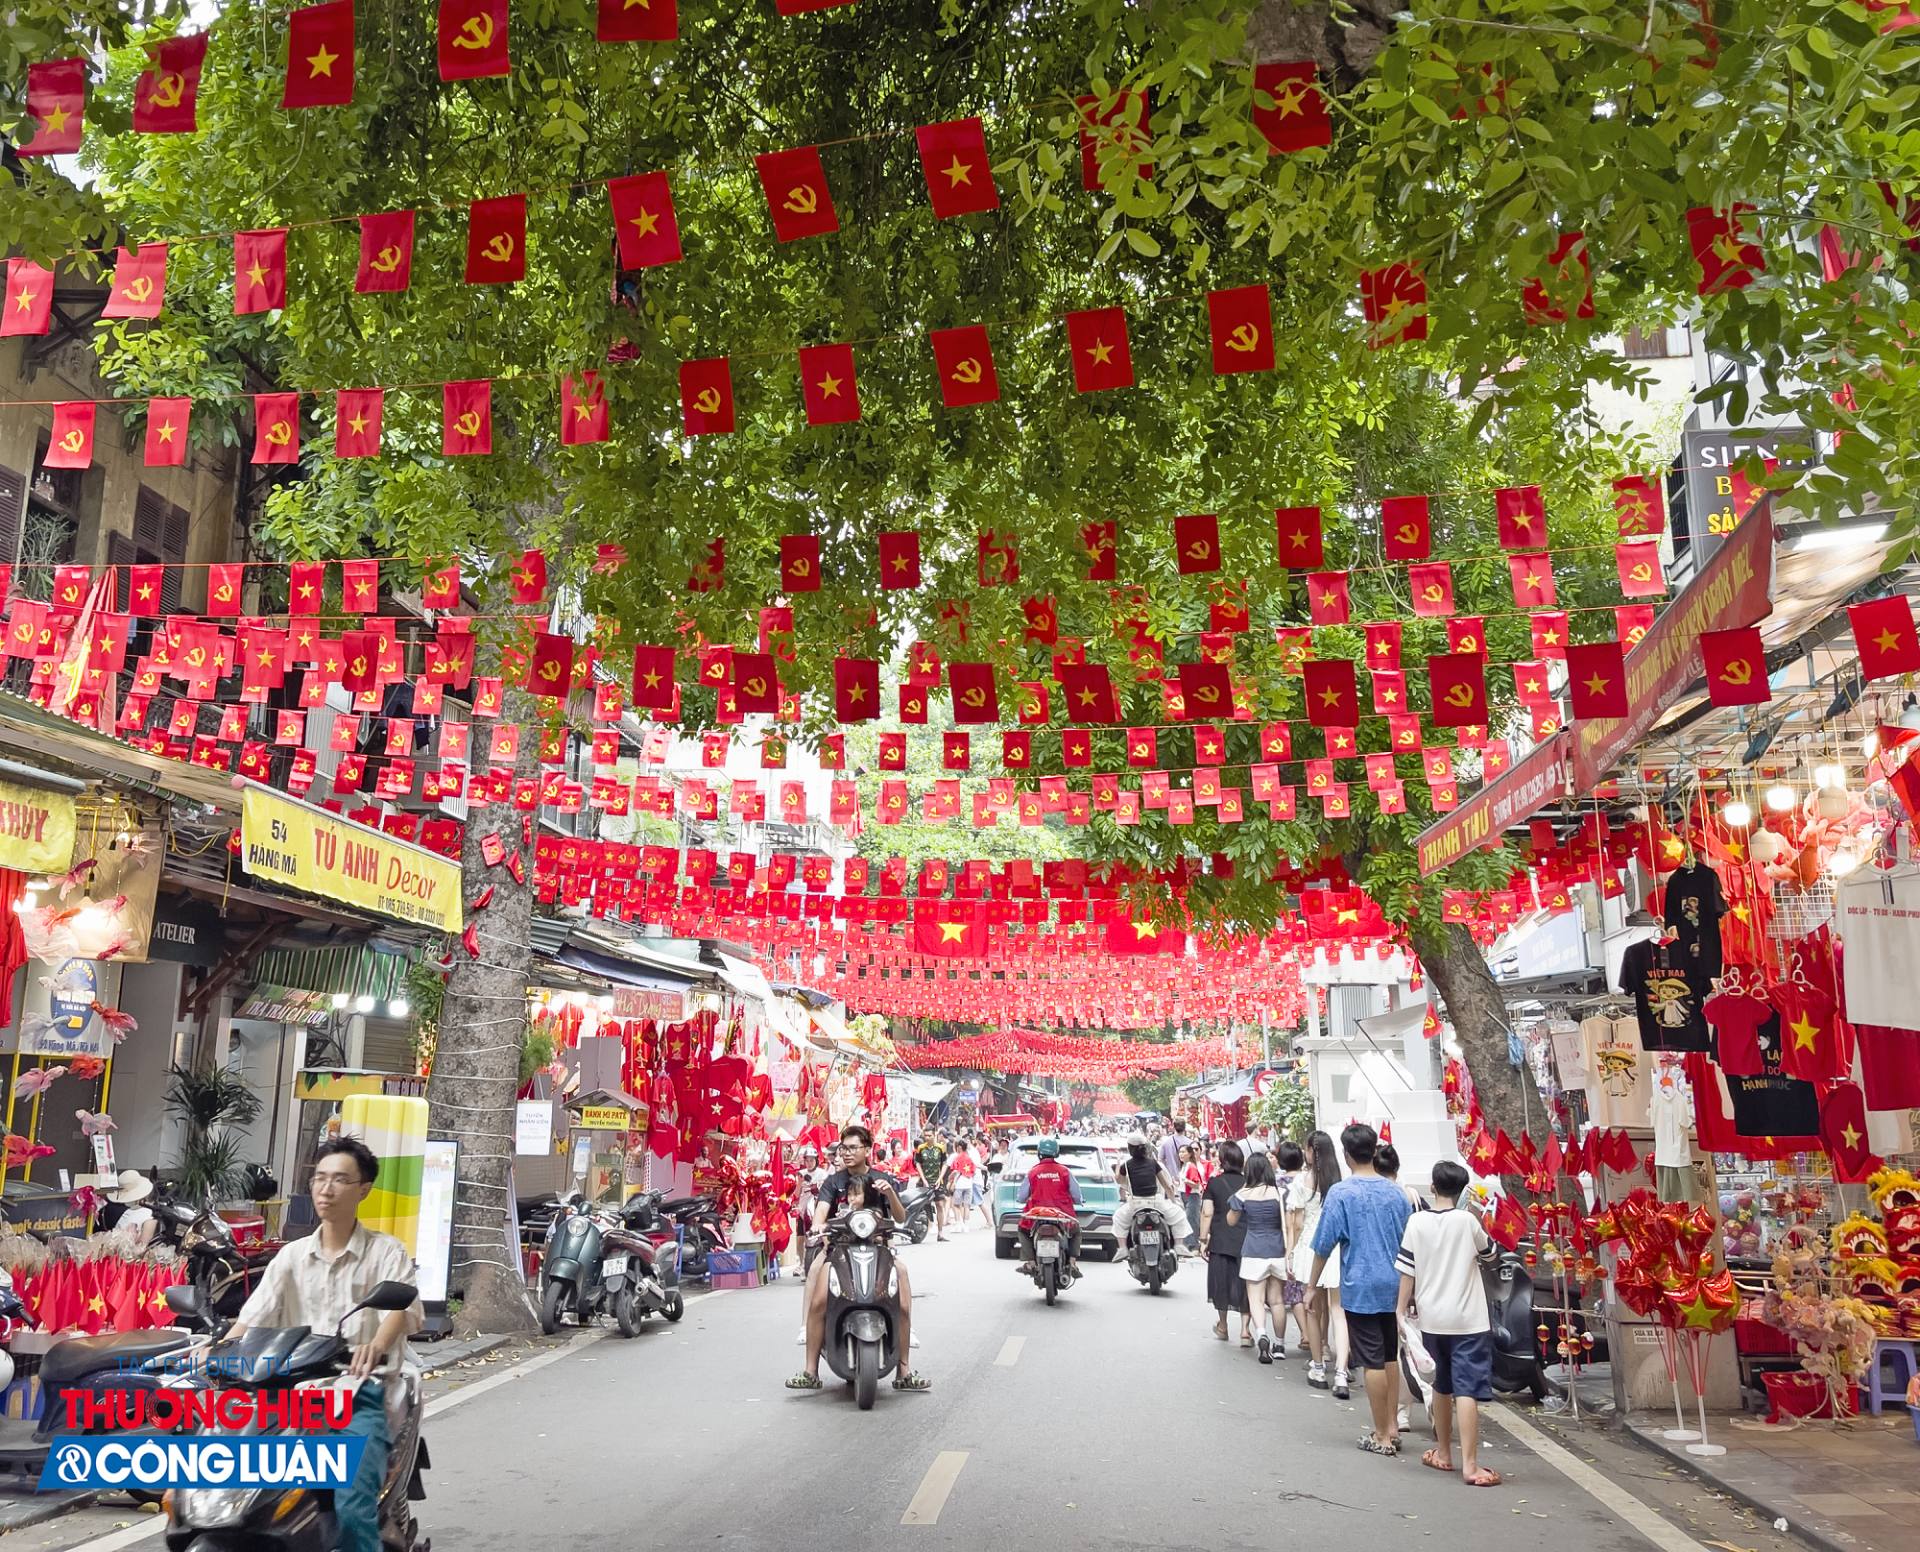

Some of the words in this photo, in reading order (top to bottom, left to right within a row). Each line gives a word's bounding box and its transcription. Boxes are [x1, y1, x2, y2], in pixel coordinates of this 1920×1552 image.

[1700, 444, 1808, 468] SIN
[271, 818, 287, 843] 54
[1423, 826, 1461, 870] THANH
[1462, 798, 1491, 847] THƯ
[249, 842, 280, 870] HÀNG
[281, 854, 297, 876] MÃ
[315, 826, 337, 871] TÚ
[342, 840, 380, 885] ANH
[386, 856, 437, 901] Decor
[153, 921, 195, 944] ATELIER
[1647, 969, 1666, 979] VIỆT
[246, 999, 271, 1015] TRÀ
[265, 1002, 291, 1019] TRÁI
[1597, 1040, 1613, 1050] VIỆT
[1615, 1042, 1634, 1050] NAM
[1767, 1049, 1783, 1063] LẬ
[1767, 1065, 1781, 1076] DO
[1741, 1079, 1768, 1092] HẠNH
[585, 1109, 601, 1118] BÁNH
[33, 1217, 61, 1230] classic
